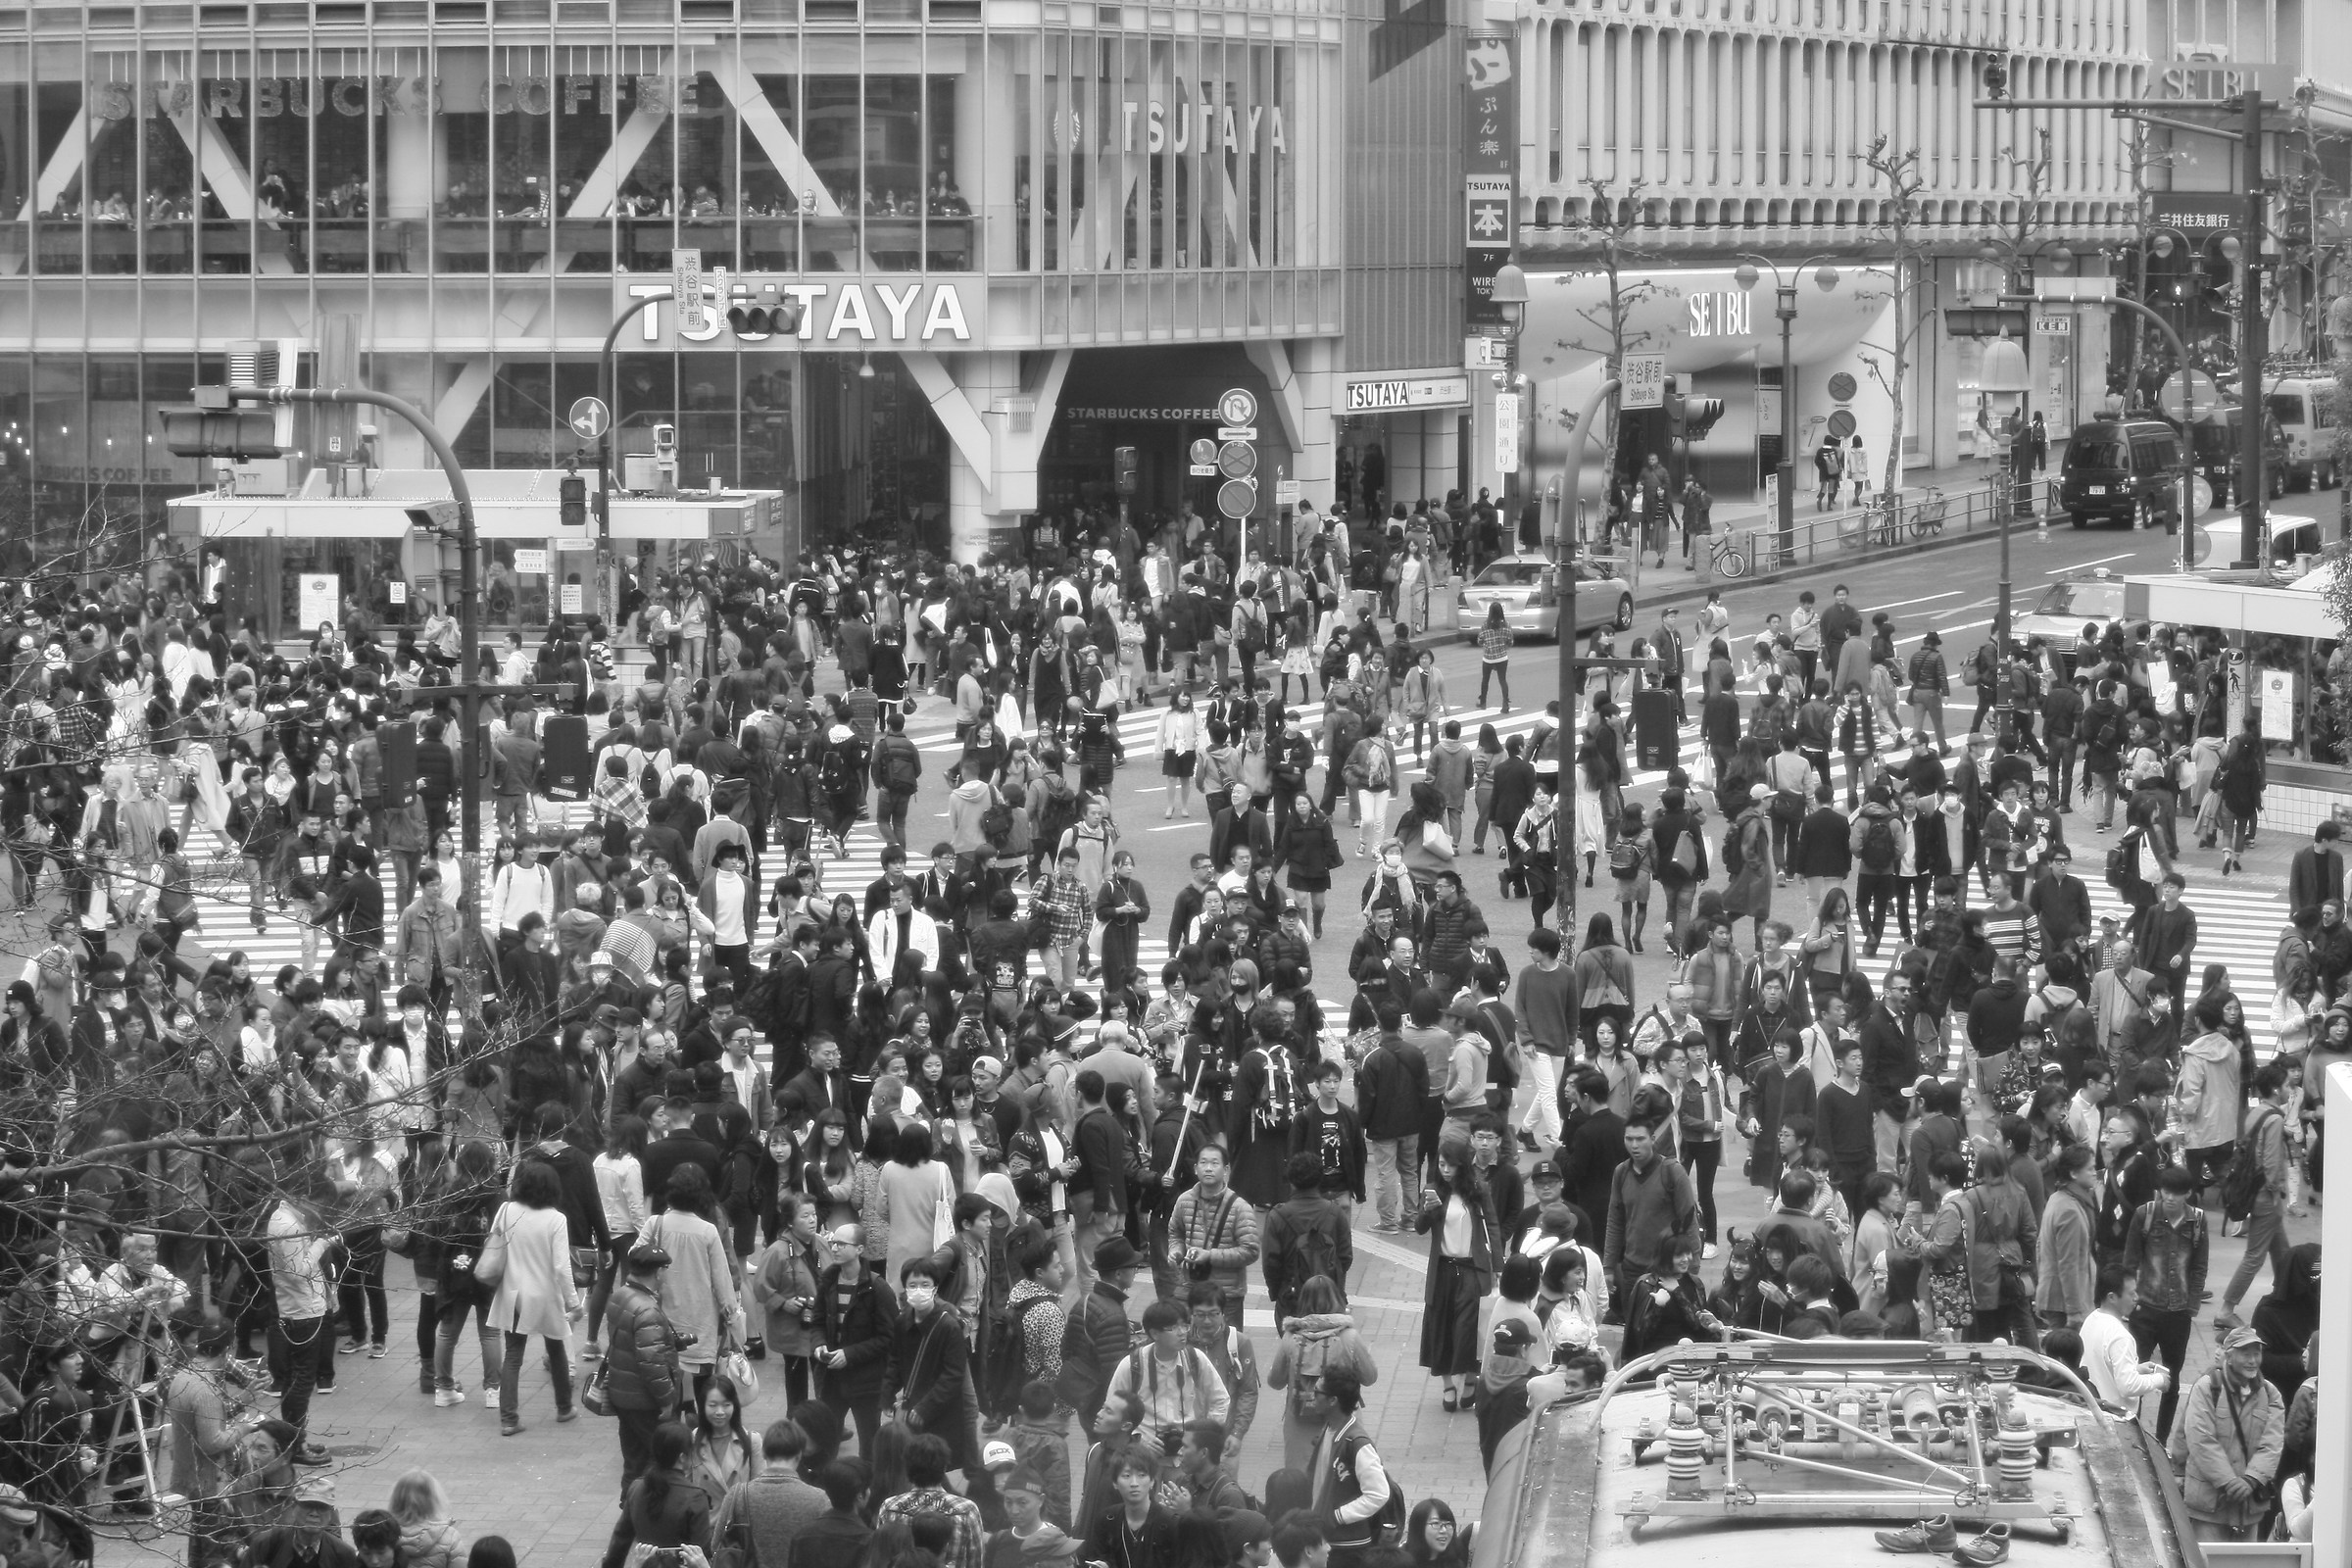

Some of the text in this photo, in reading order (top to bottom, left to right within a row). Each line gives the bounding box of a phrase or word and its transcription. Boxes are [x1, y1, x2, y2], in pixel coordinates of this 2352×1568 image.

[103, 74, 700, 122] STARBUCKS COFFEE
[1123, 101, 1288, 155] TSUTAYA
[1480, 97, 1500, 156] ぷん楽
[1468, 182, 1511, 192] TSUTAYA
[1474, 204, 1504, 237] 本
[2159, 213, 2230, 228] 三井住友銀行
[1483, 253, 1494, 263] 7F
[676, 267, 685, 299] Shibuya
[685, 256, 701, 326] 渋谷駅前
[1472, 276, 1496, 287] WIRE
[1690, 291, 1751, 337] SEIBU
[1626, 360, 1662, 384] 渋谷駅前
[1348, 382, 1409, 408] TSUTAYA
[1067, 407, 1220, 420] STARBUCKS COFFEE
[1498, 399, 1510, 466] 公園通り
[2231, 652, 2238, 661] 7
[989, 1447, 1011, 1457] SOX
